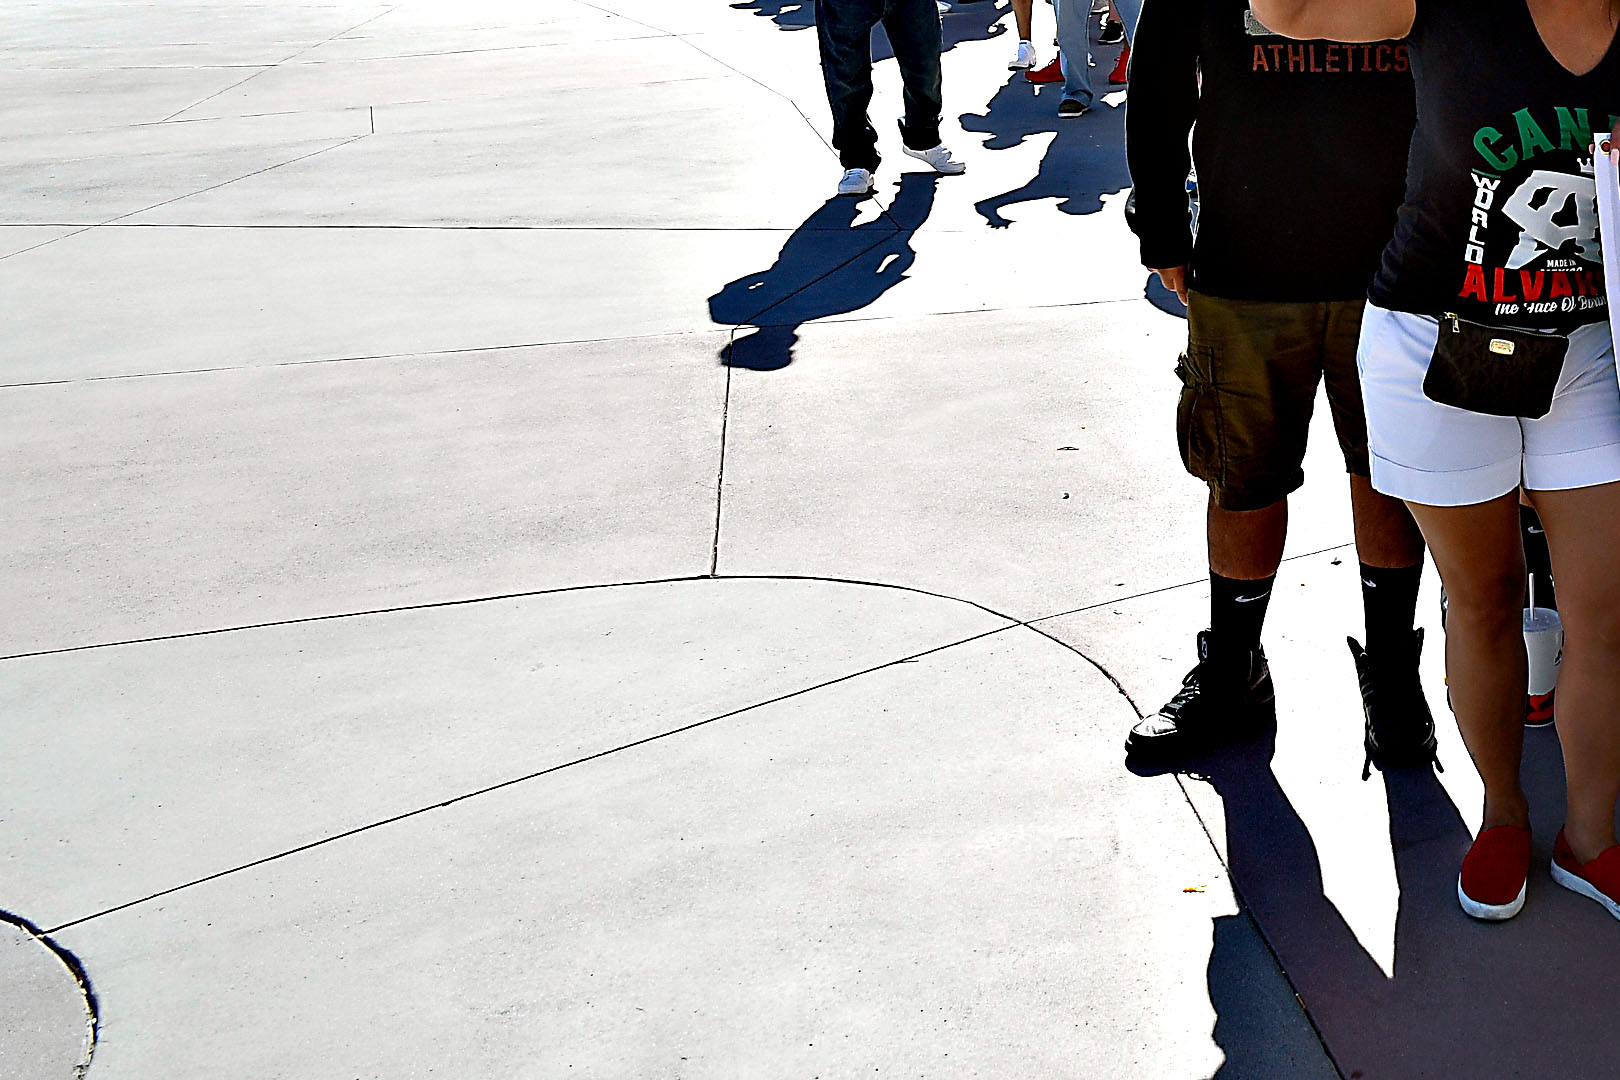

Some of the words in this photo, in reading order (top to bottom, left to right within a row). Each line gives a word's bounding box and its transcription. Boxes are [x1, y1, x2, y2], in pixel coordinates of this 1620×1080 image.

[1252, 44, 1409, 72] ATHLETICS
[1473, 106, 1618, 171] CAN
[1464, 172, 1501, 265] WORLD
[1458, 263, 1603, 303] ALVAR
[1546, 259, 1568, 268] MADE
